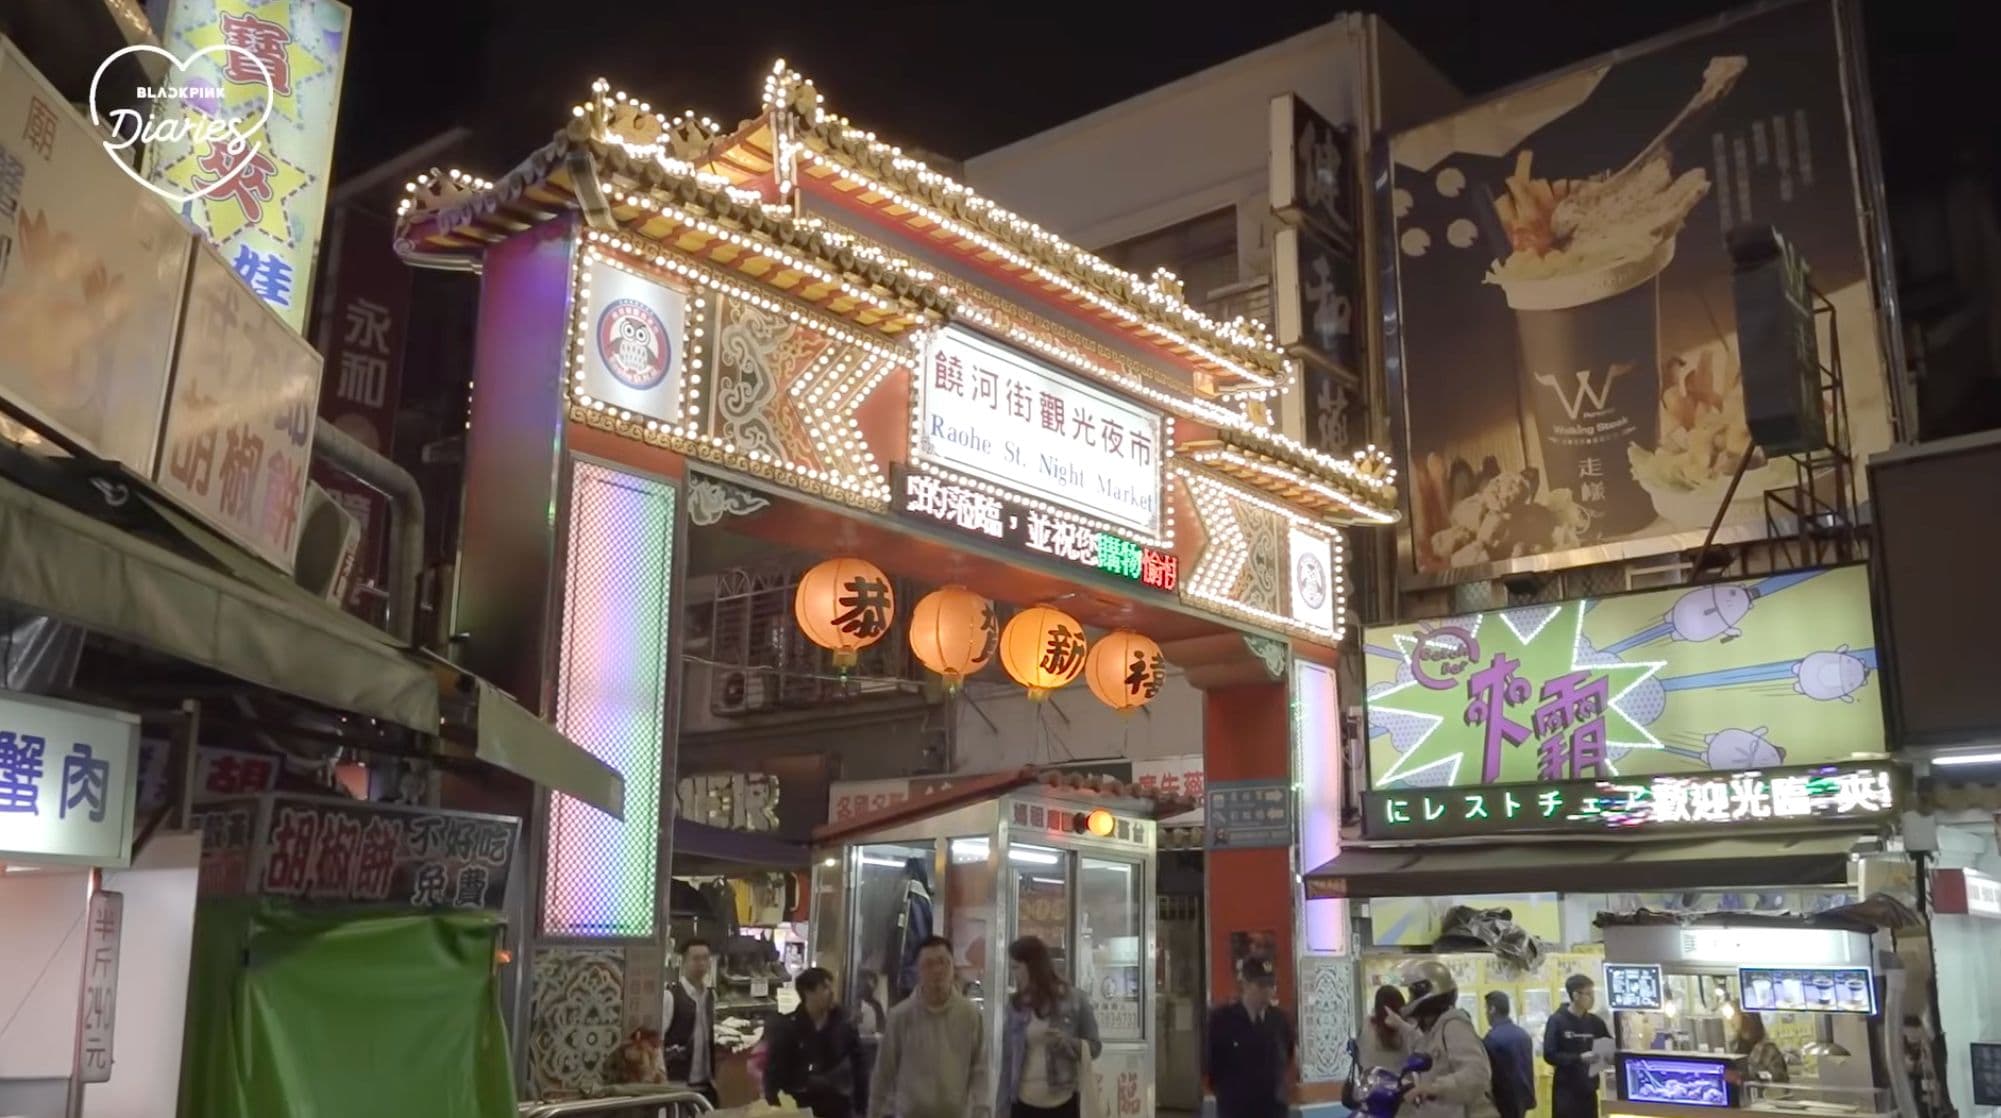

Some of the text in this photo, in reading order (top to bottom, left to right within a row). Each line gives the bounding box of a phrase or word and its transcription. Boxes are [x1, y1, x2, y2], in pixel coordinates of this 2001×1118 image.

[337, 297, 392, 408] 永和
[934, 349, 1152, 467] 饒河街觀光夜市
[930, 413, 1153, 513] Raohe St. Night Market
[831, 575, 891, 638] 恭
[1040, 623, 1085, 680] 新
[0, 729, 110, 823] 蟹肉
[263, 806, 400, 900] 胡椒餅
[400, 814, 513, 865] 不好吃
[411, 863, 490, 909] 免費
